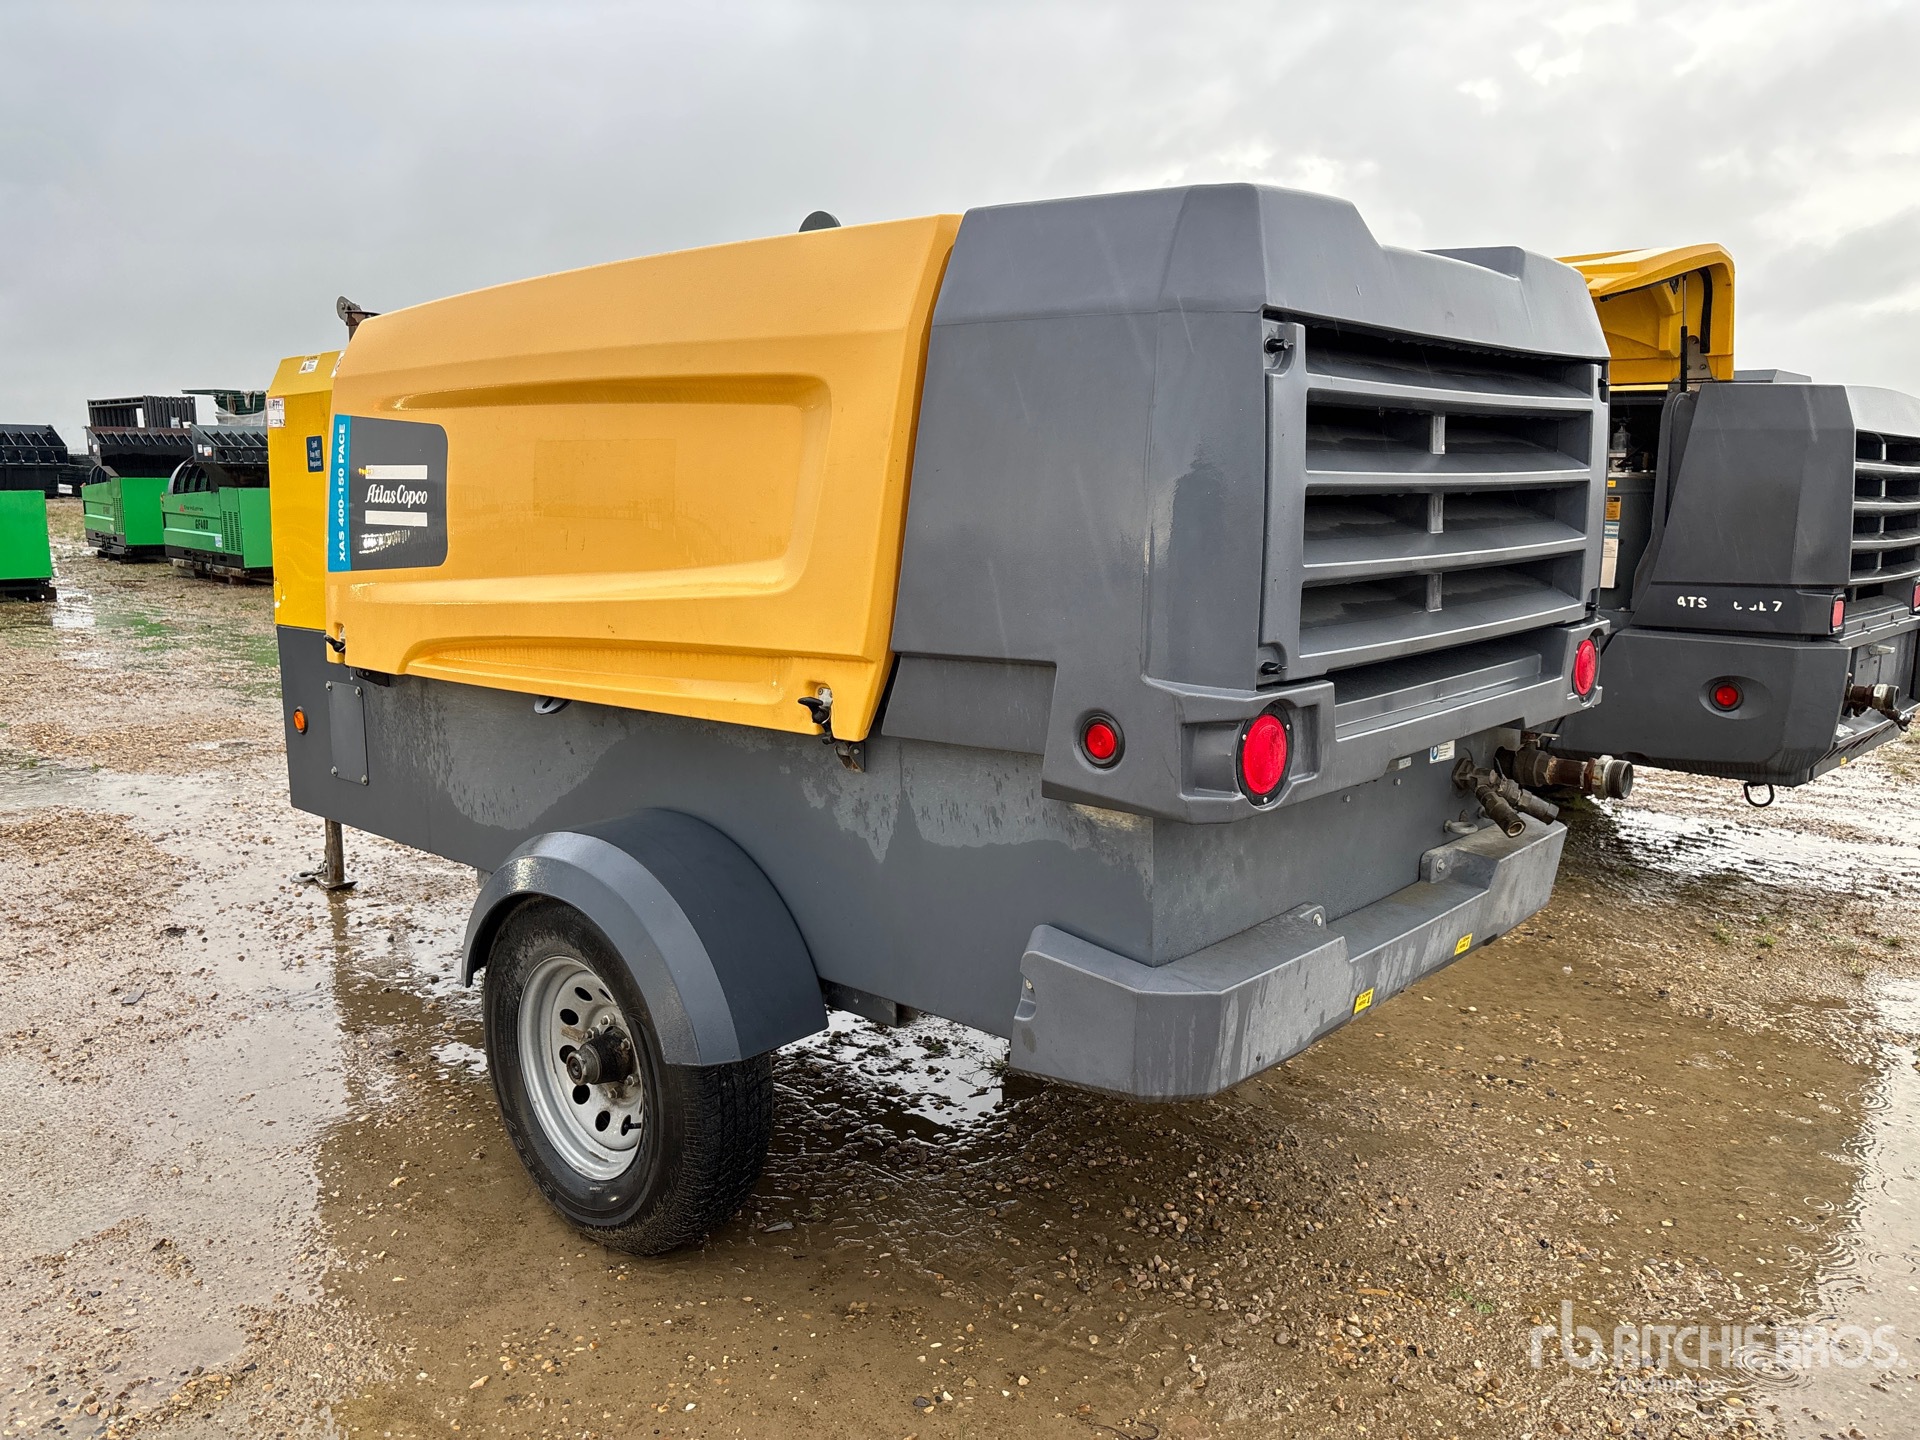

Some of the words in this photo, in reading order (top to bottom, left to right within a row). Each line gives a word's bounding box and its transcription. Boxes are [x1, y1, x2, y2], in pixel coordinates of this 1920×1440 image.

[338, 424, 346, 463] PACE
[364, 484, 397, 504] Atlas
[396, 484, 428, 509] Copco
[338, 531, 346, 562] XAS
